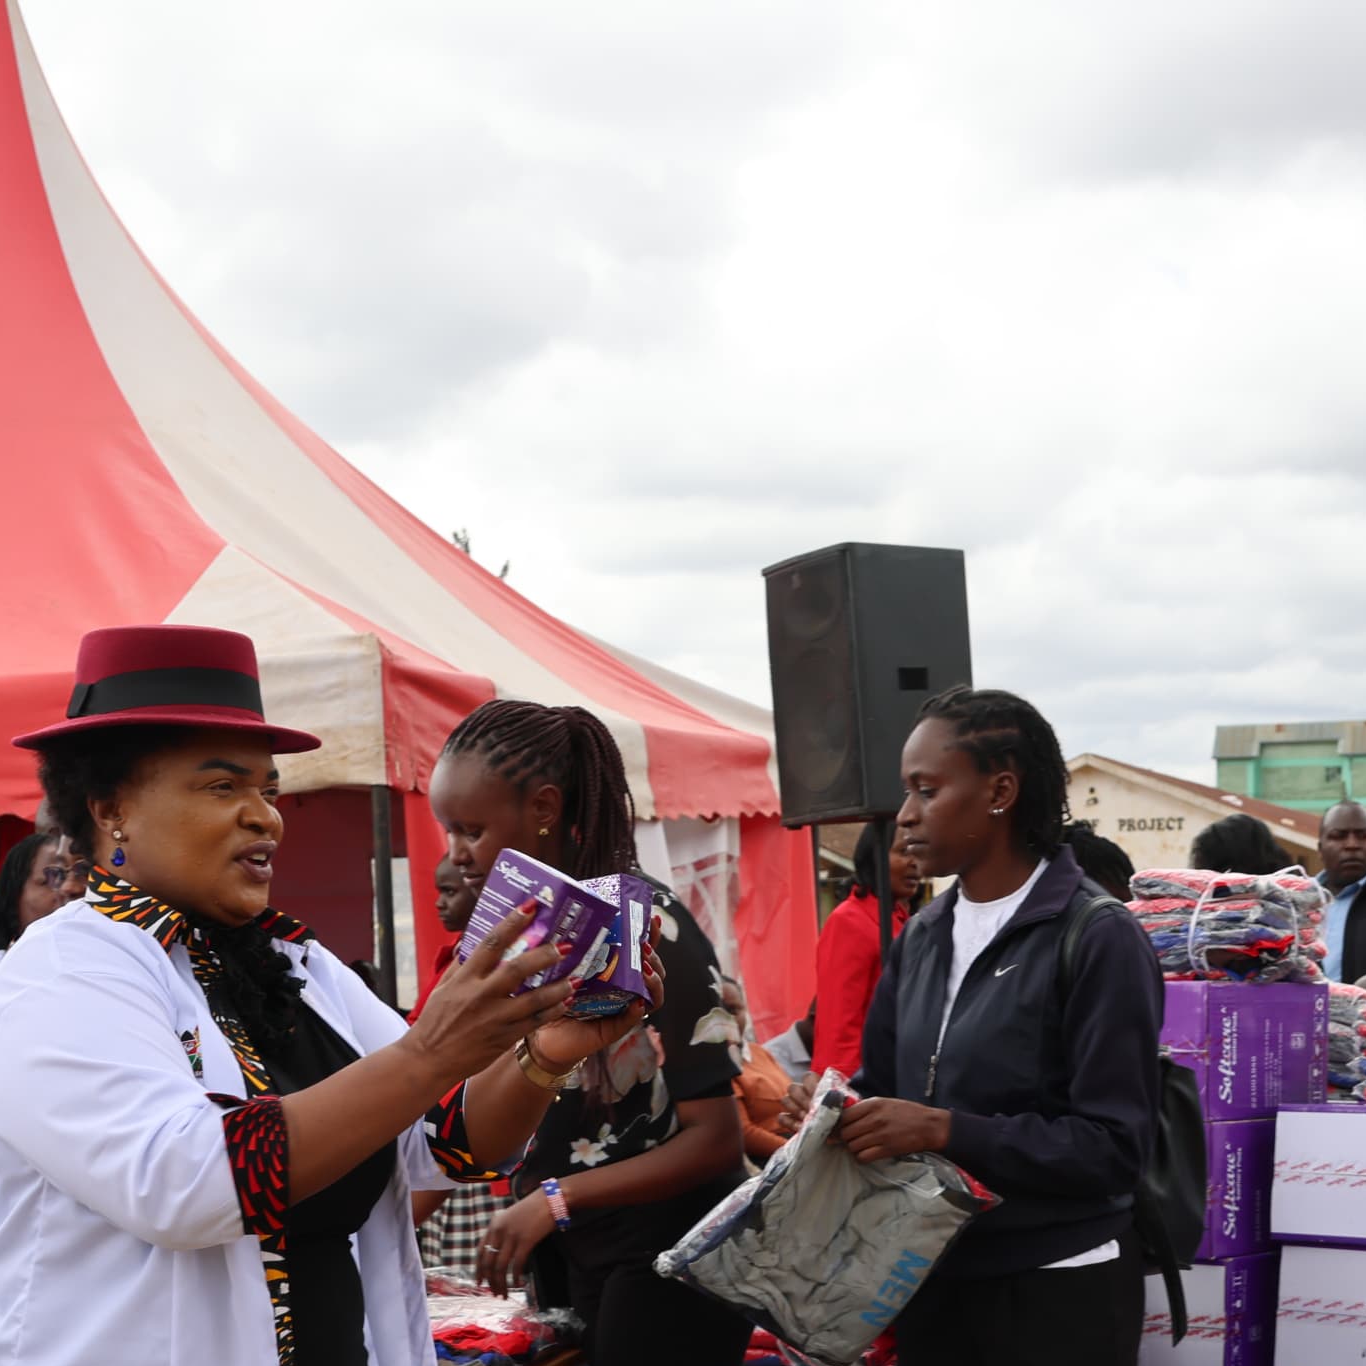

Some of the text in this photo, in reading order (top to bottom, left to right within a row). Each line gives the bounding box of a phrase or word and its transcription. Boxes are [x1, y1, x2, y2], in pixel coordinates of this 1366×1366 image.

[1117, 817, 1184, 832] PROJECT
[1218, 1016, 1235, 1104] Softcare
[1223, 1152, 1240, 1240] Softcare
[859, 1249, 932, 1329] MEN
